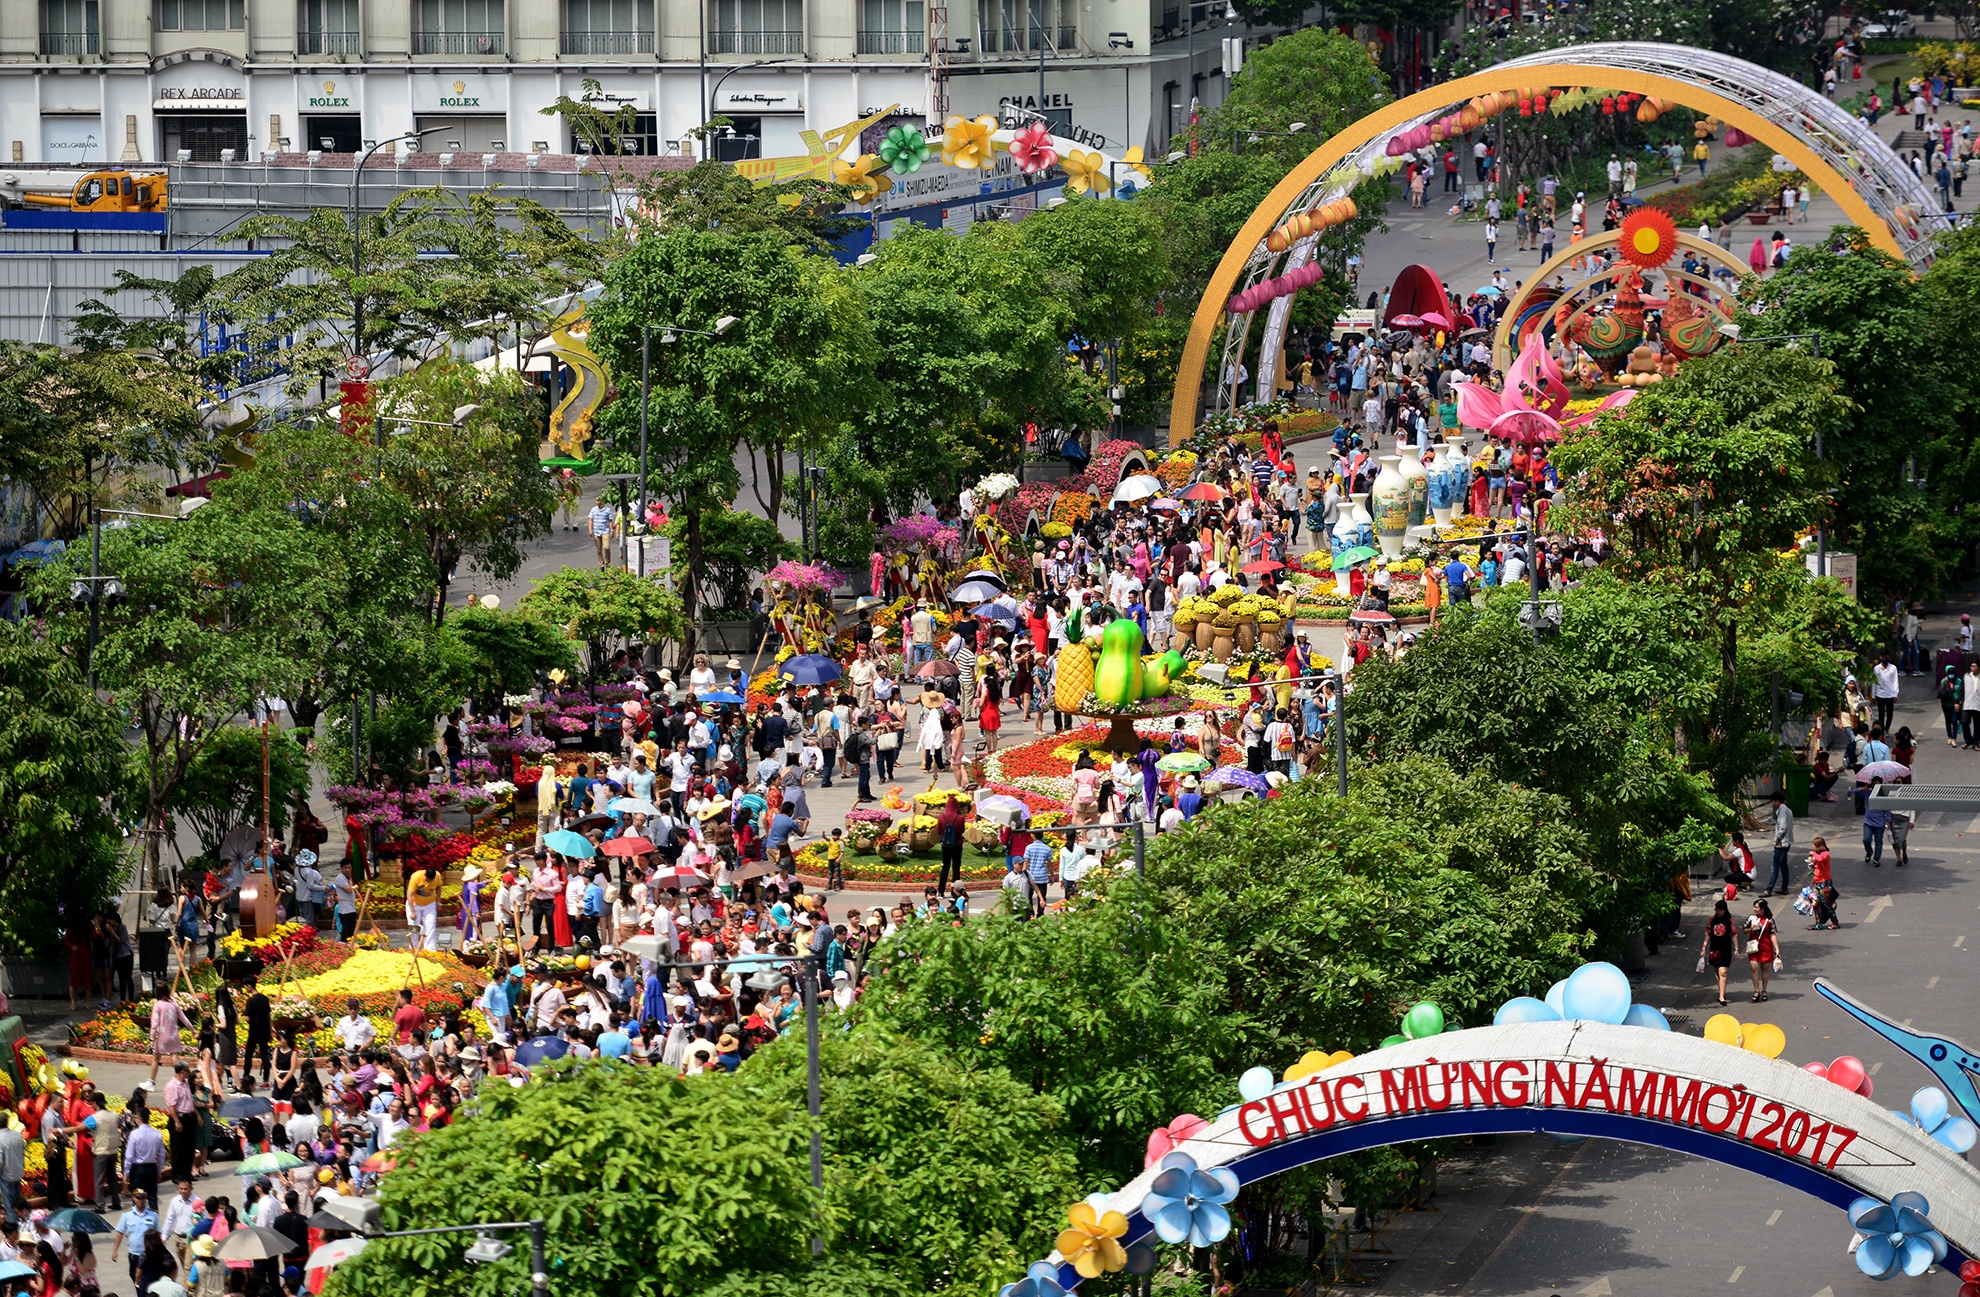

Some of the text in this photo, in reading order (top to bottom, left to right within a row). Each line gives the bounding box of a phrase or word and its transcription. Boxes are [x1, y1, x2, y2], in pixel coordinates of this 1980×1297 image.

[160, 88, 242, 99] REX ARCADE
[309, 97, 349, 107] ROLEX
[439, 97, 480, 107] ROLEX
[999, 94, 1073, 108] CHANEL
[866, 107, 918, 116] CHNEL
[1238, 1075, 1369, 1147] CHÚC
[1379, 1056, 1530, 1115] MỪNG
[1750, 1103, 1859, 1170] 2017
